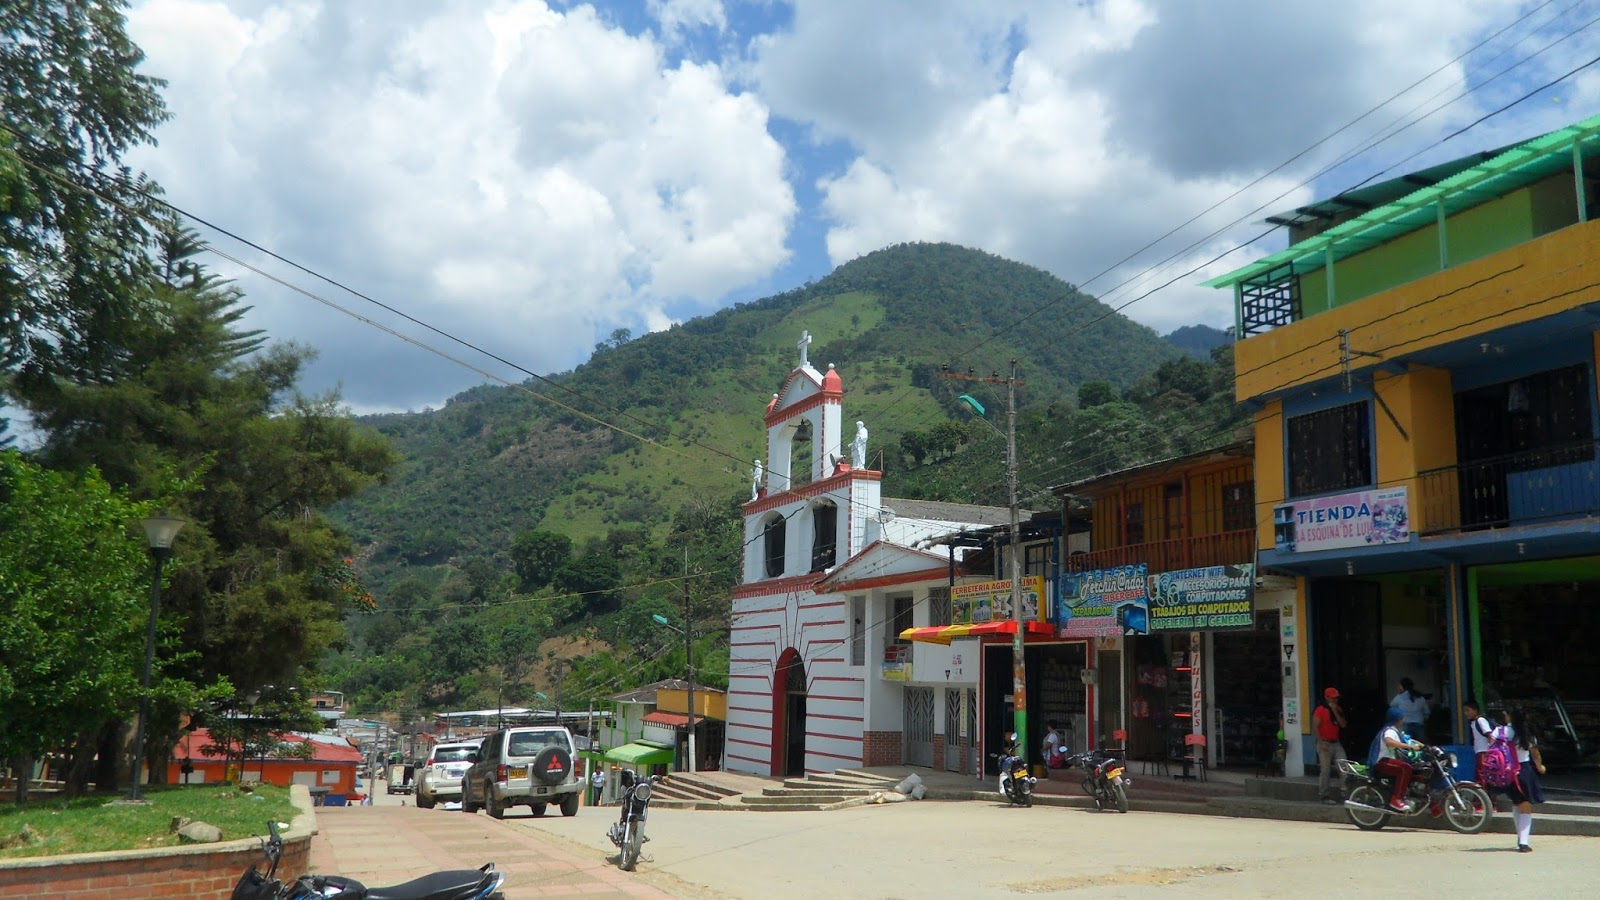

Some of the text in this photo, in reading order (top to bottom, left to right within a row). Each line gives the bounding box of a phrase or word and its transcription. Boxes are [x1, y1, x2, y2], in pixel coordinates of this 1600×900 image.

[1297, 502, 1371, 525] TIENDA
[1296, 521, 1375, 543] LA ESQUINA DE LUIS
[1172, 570, 1205, 580] INTERNET
[952, 584, 990, 595] FERRETERIA
[1181, 576, 1250, 592] ACCESORIOS PARA
[1186, 590, 1246, 603] COMPUTADORES
[1151, 601, 1250, 618] TRABAJOS EN COMPUTADOR
[1151, 613, 1252, 629] PAPELERIA EN GENERAL
